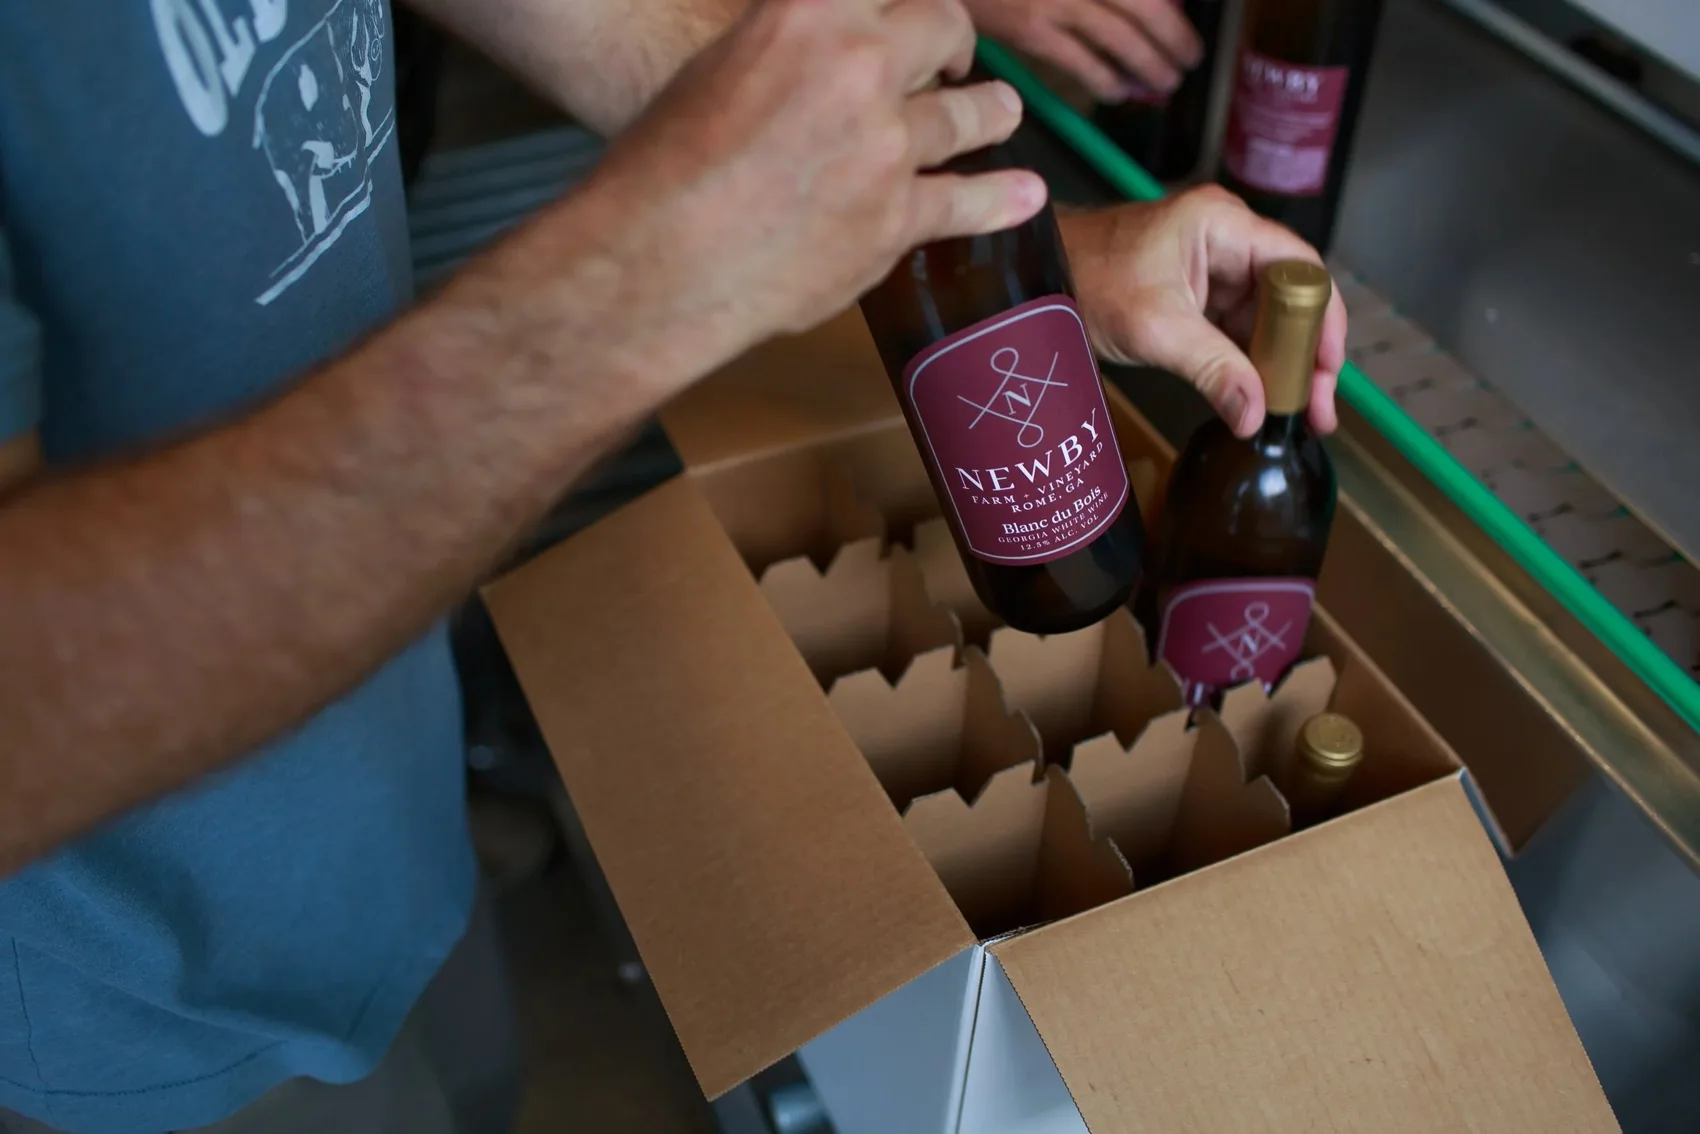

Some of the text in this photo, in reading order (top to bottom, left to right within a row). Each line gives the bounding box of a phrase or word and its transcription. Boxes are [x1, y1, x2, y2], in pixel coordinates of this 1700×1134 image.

[1002, 383, 1032, 416] N
[955, 408, 1100, 491] NEWBY
[972, 494, 1016, 505] FARM
[1037, 442, 1104, 495] VINEYARD
[1002, 486, 1102, 535] Blanc du Bois
[1011, 478, 1085, 513] ROME, GA
[998, 492, 1109, 543] GEORGIA WHITE WINE
[1020, 515, 1099, 551] 12.5% ALC. VOL
[1238, 633, 1262, 657] N
